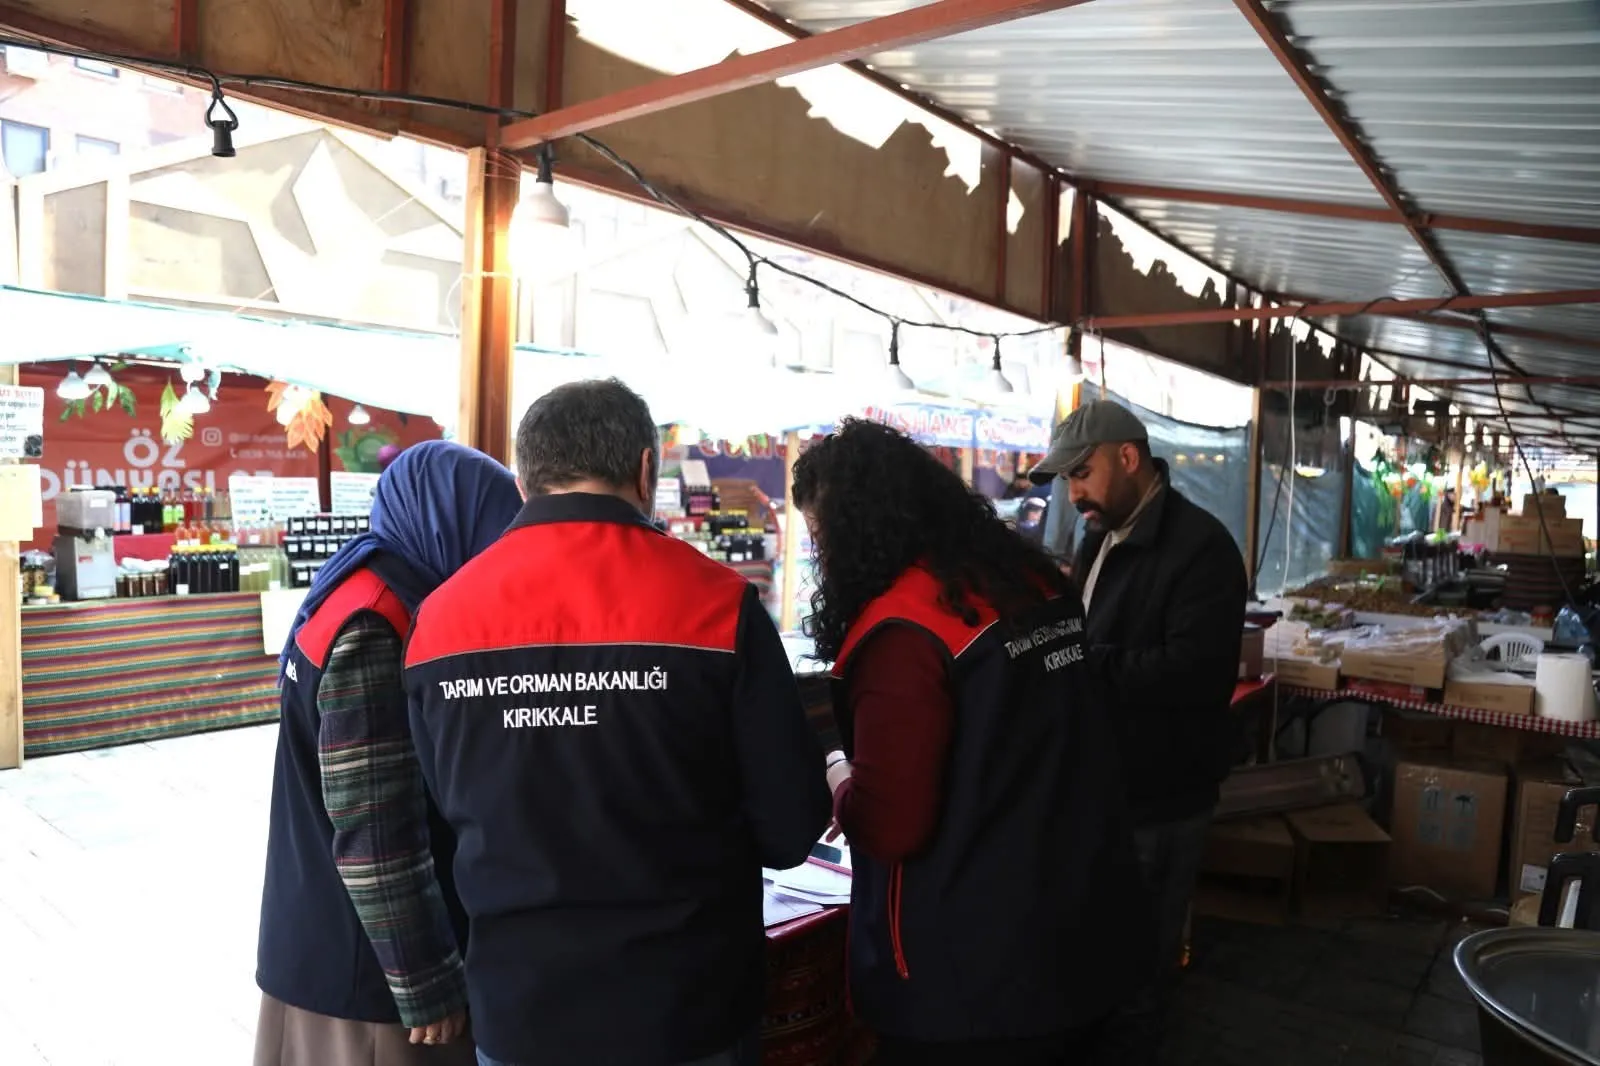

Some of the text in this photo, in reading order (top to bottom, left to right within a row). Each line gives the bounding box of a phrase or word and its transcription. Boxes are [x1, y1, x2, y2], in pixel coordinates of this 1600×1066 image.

[123, 428, 186, 469] ÖZ
[439, 666, 668, 700] TARIM VE ORMAN BAKANLIĞI
[503, 705, 599, 729] KIRIKKALE
